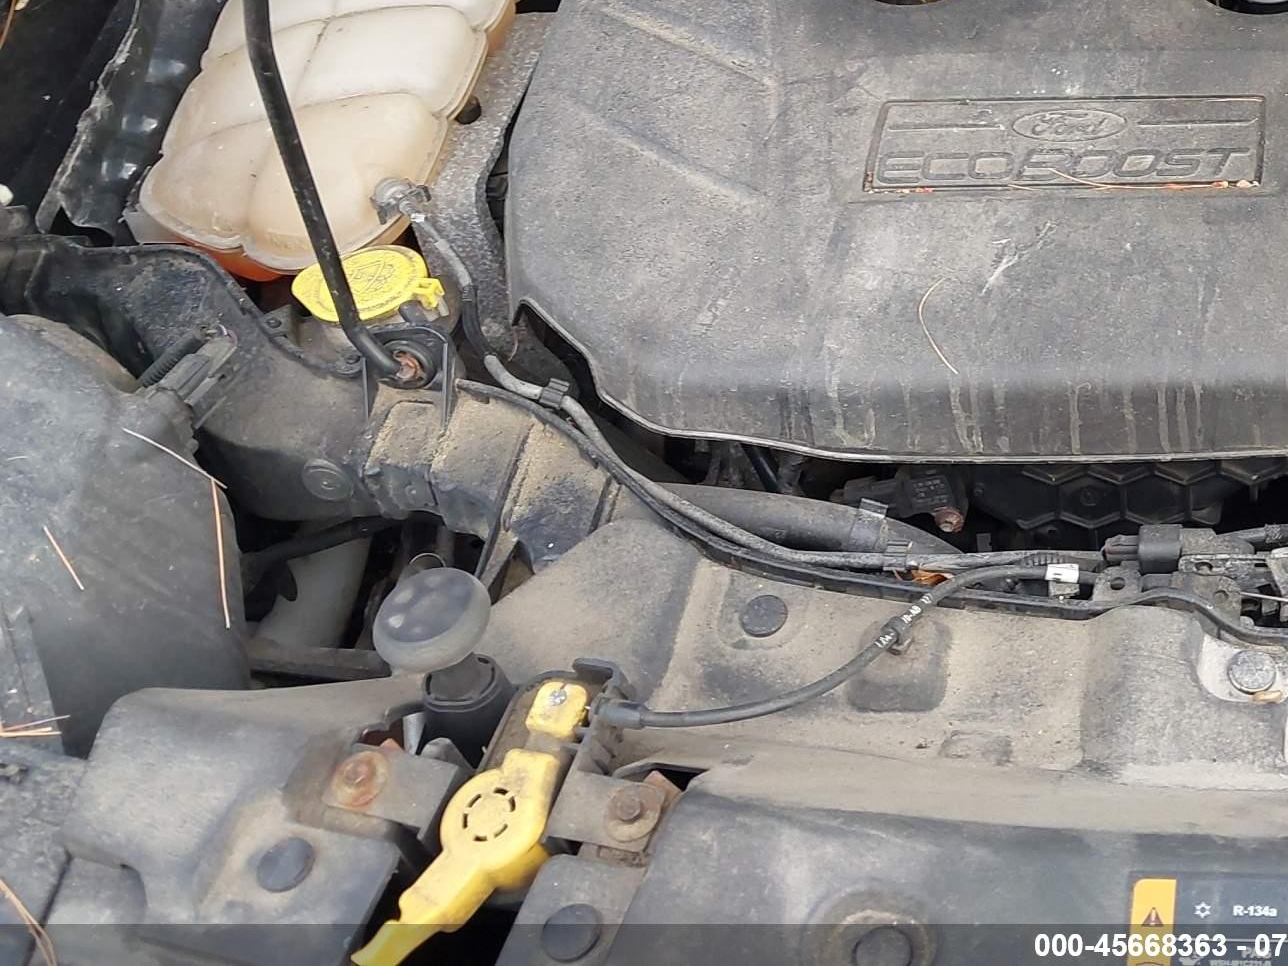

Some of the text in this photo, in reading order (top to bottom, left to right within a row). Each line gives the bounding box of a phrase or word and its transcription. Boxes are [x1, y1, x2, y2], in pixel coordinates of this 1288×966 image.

[1030, 110, 1111, 139] Ford
[877, 146, 1250, 185] ECOBOOST
[1232, 905, 1278, 917] R-134a
